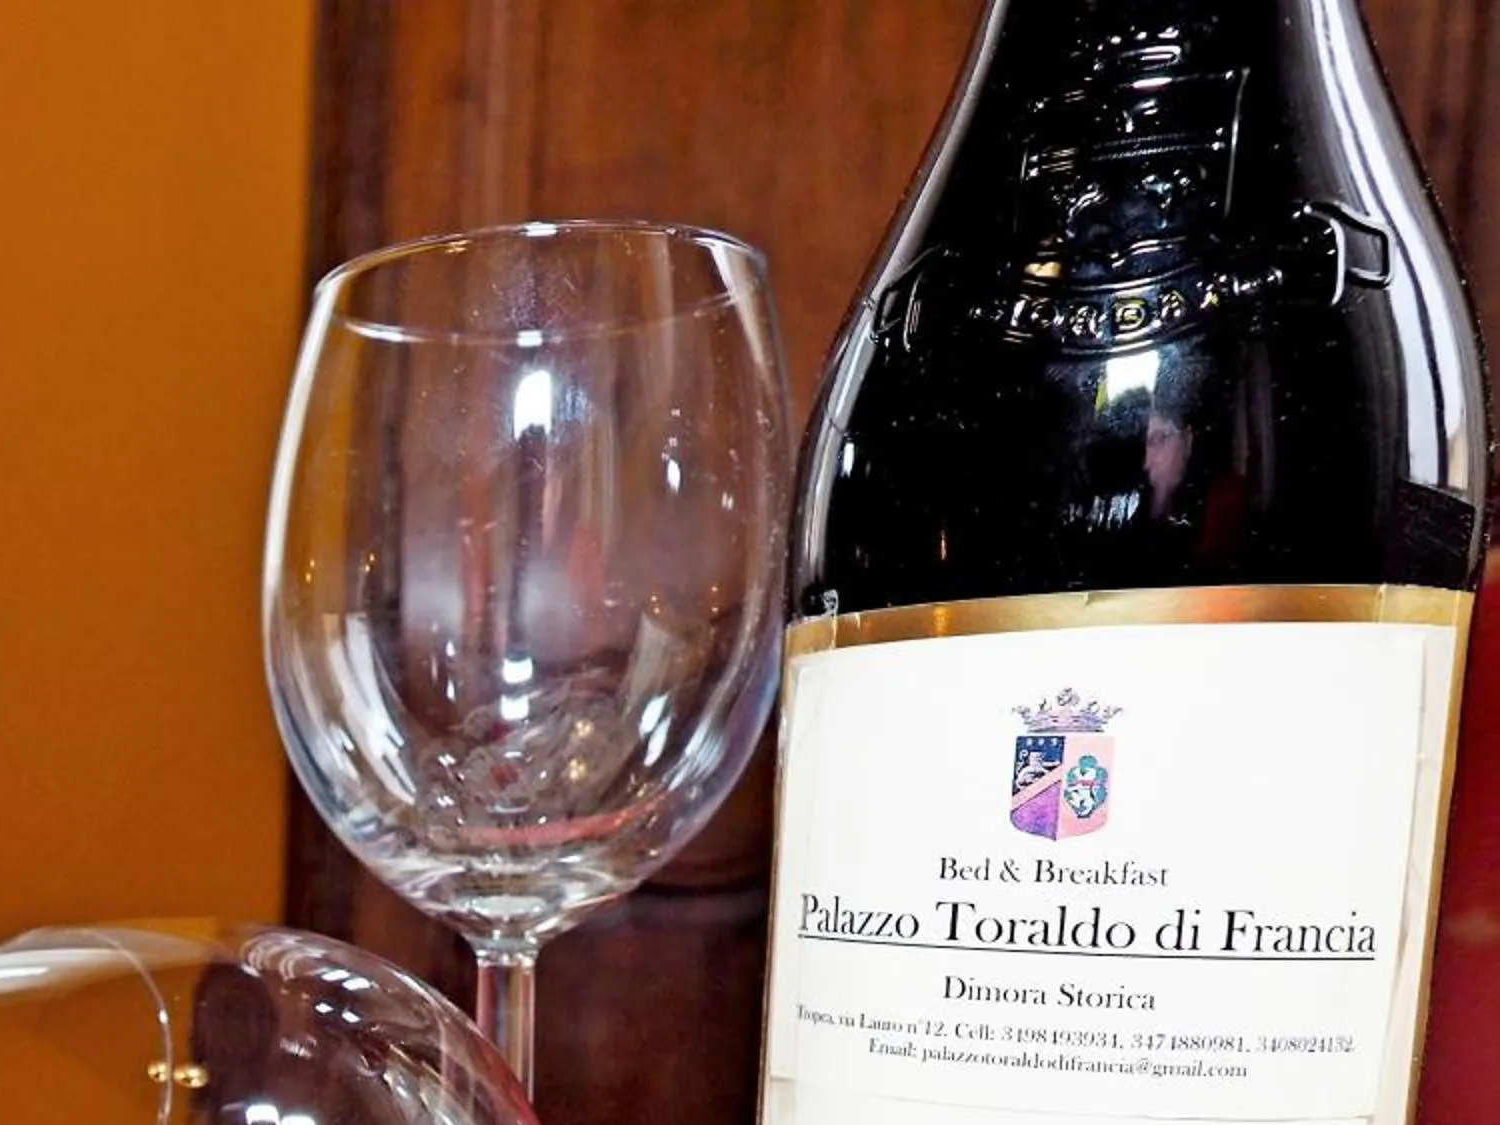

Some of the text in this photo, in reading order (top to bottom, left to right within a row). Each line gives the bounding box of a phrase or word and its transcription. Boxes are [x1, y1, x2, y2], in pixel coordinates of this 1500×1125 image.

[938, 857, 1171, 888] Bed & Breakfast
[798, 893, 1378, 955] Palazzo Toraldo di Francia
[943, 975, 1157, 1012] Dimora Storica
[859, 1013, 904, 1033] Lauro
[954, 1021, 995, 1042] Cell:
[869, 1037, 917, 1059] Email:
